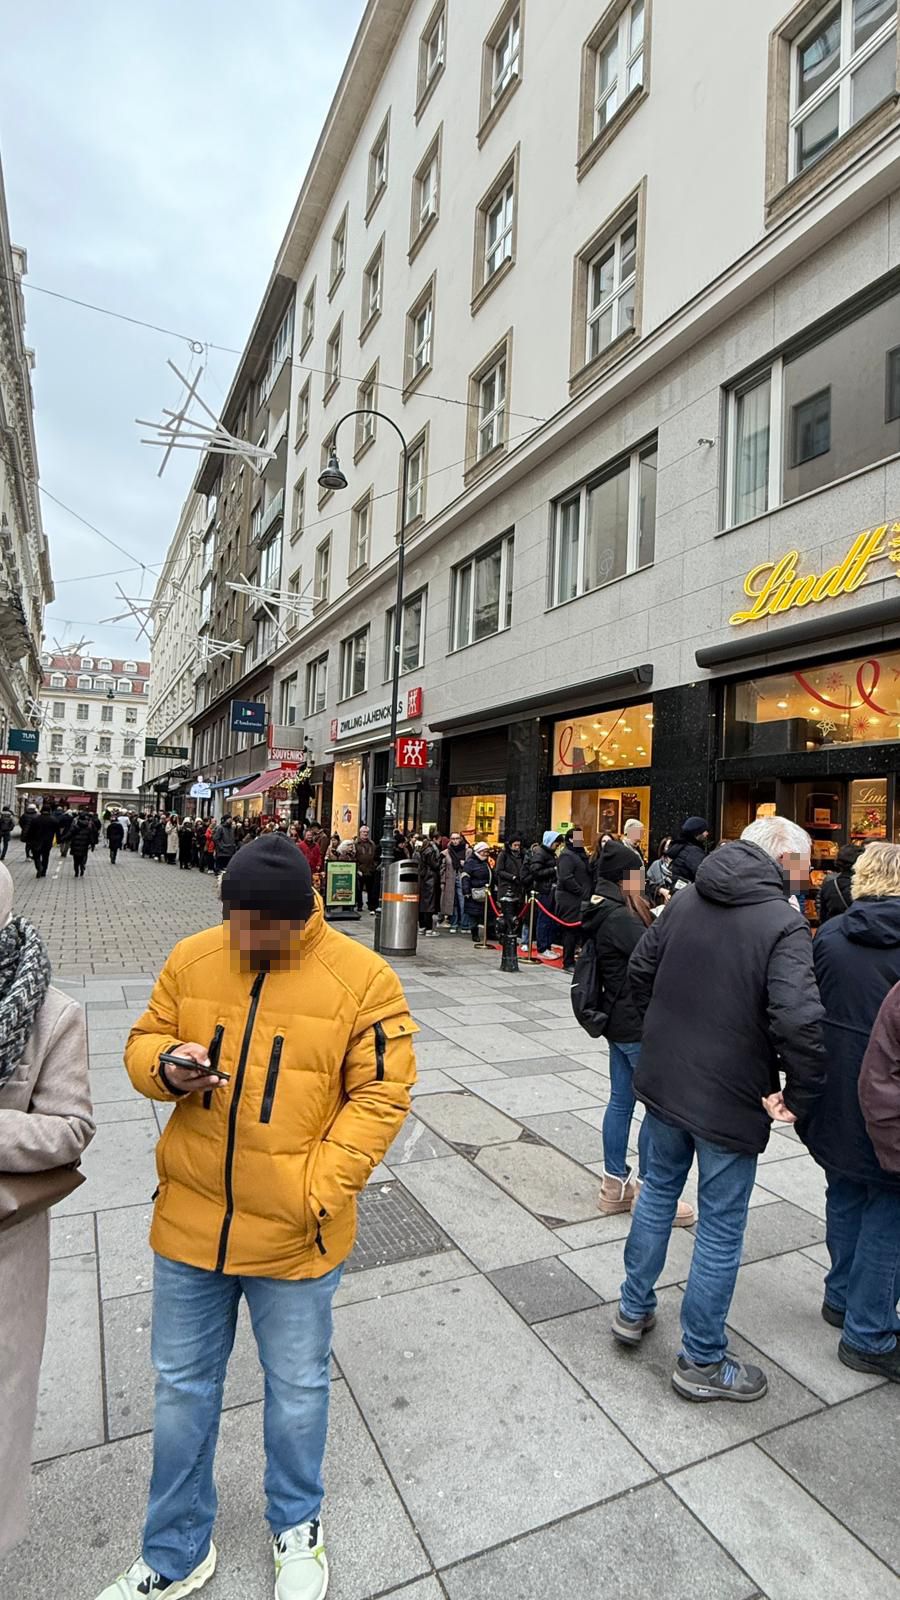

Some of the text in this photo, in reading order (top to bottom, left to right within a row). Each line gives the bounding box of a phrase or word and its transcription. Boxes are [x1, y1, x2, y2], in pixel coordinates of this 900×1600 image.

[728, 524, 889, 626] Lindt
[340, 715, 363, 733] ZWILLING
[272, 750, 304, 760] SOUVENIRS
